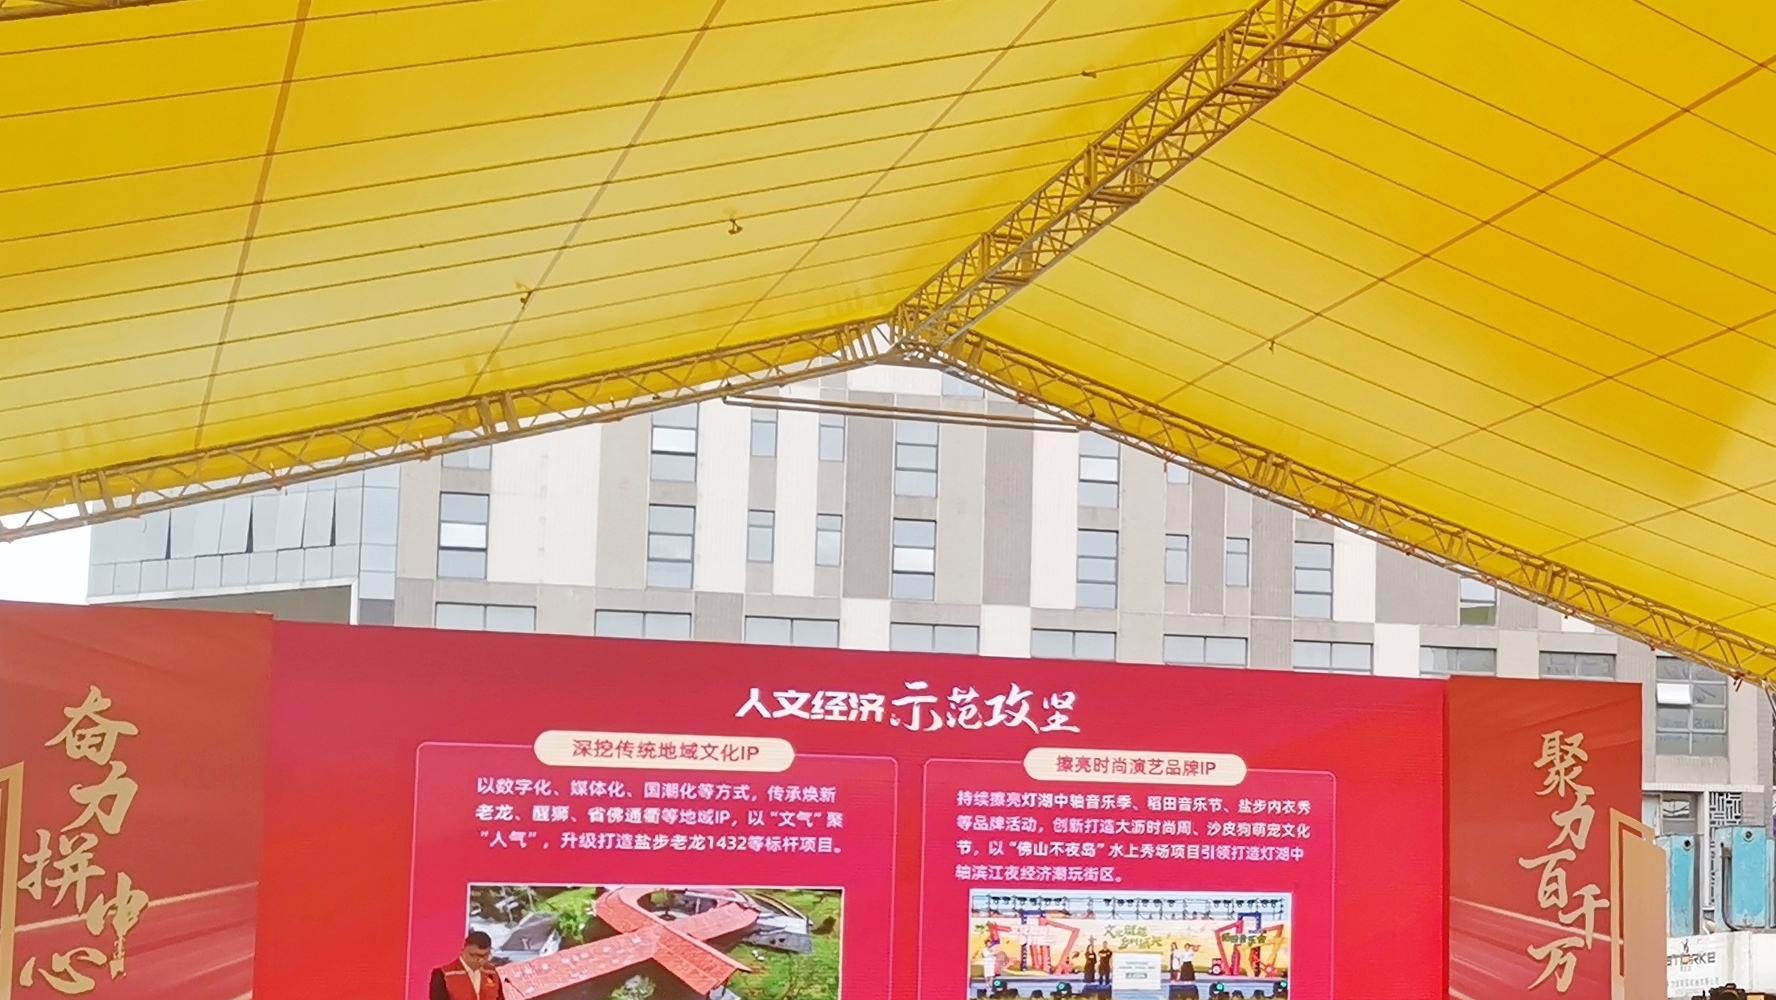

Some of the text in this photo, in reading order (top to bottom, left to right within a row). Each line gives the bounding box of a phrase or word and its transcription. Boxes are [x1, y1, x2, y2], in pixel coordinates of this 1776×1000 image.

[735, 681, 1081, 734] 人文经济示范攻坚
[572, 739, 759, 762] 深挖传统地域文化IP
[1056, 754, 1217, 777] 擦亮时尚演艺品牌IP
[17, 685, 150, 993] 奋力拼中心
[1519, 731, 1610, 993] 聚力百千万
